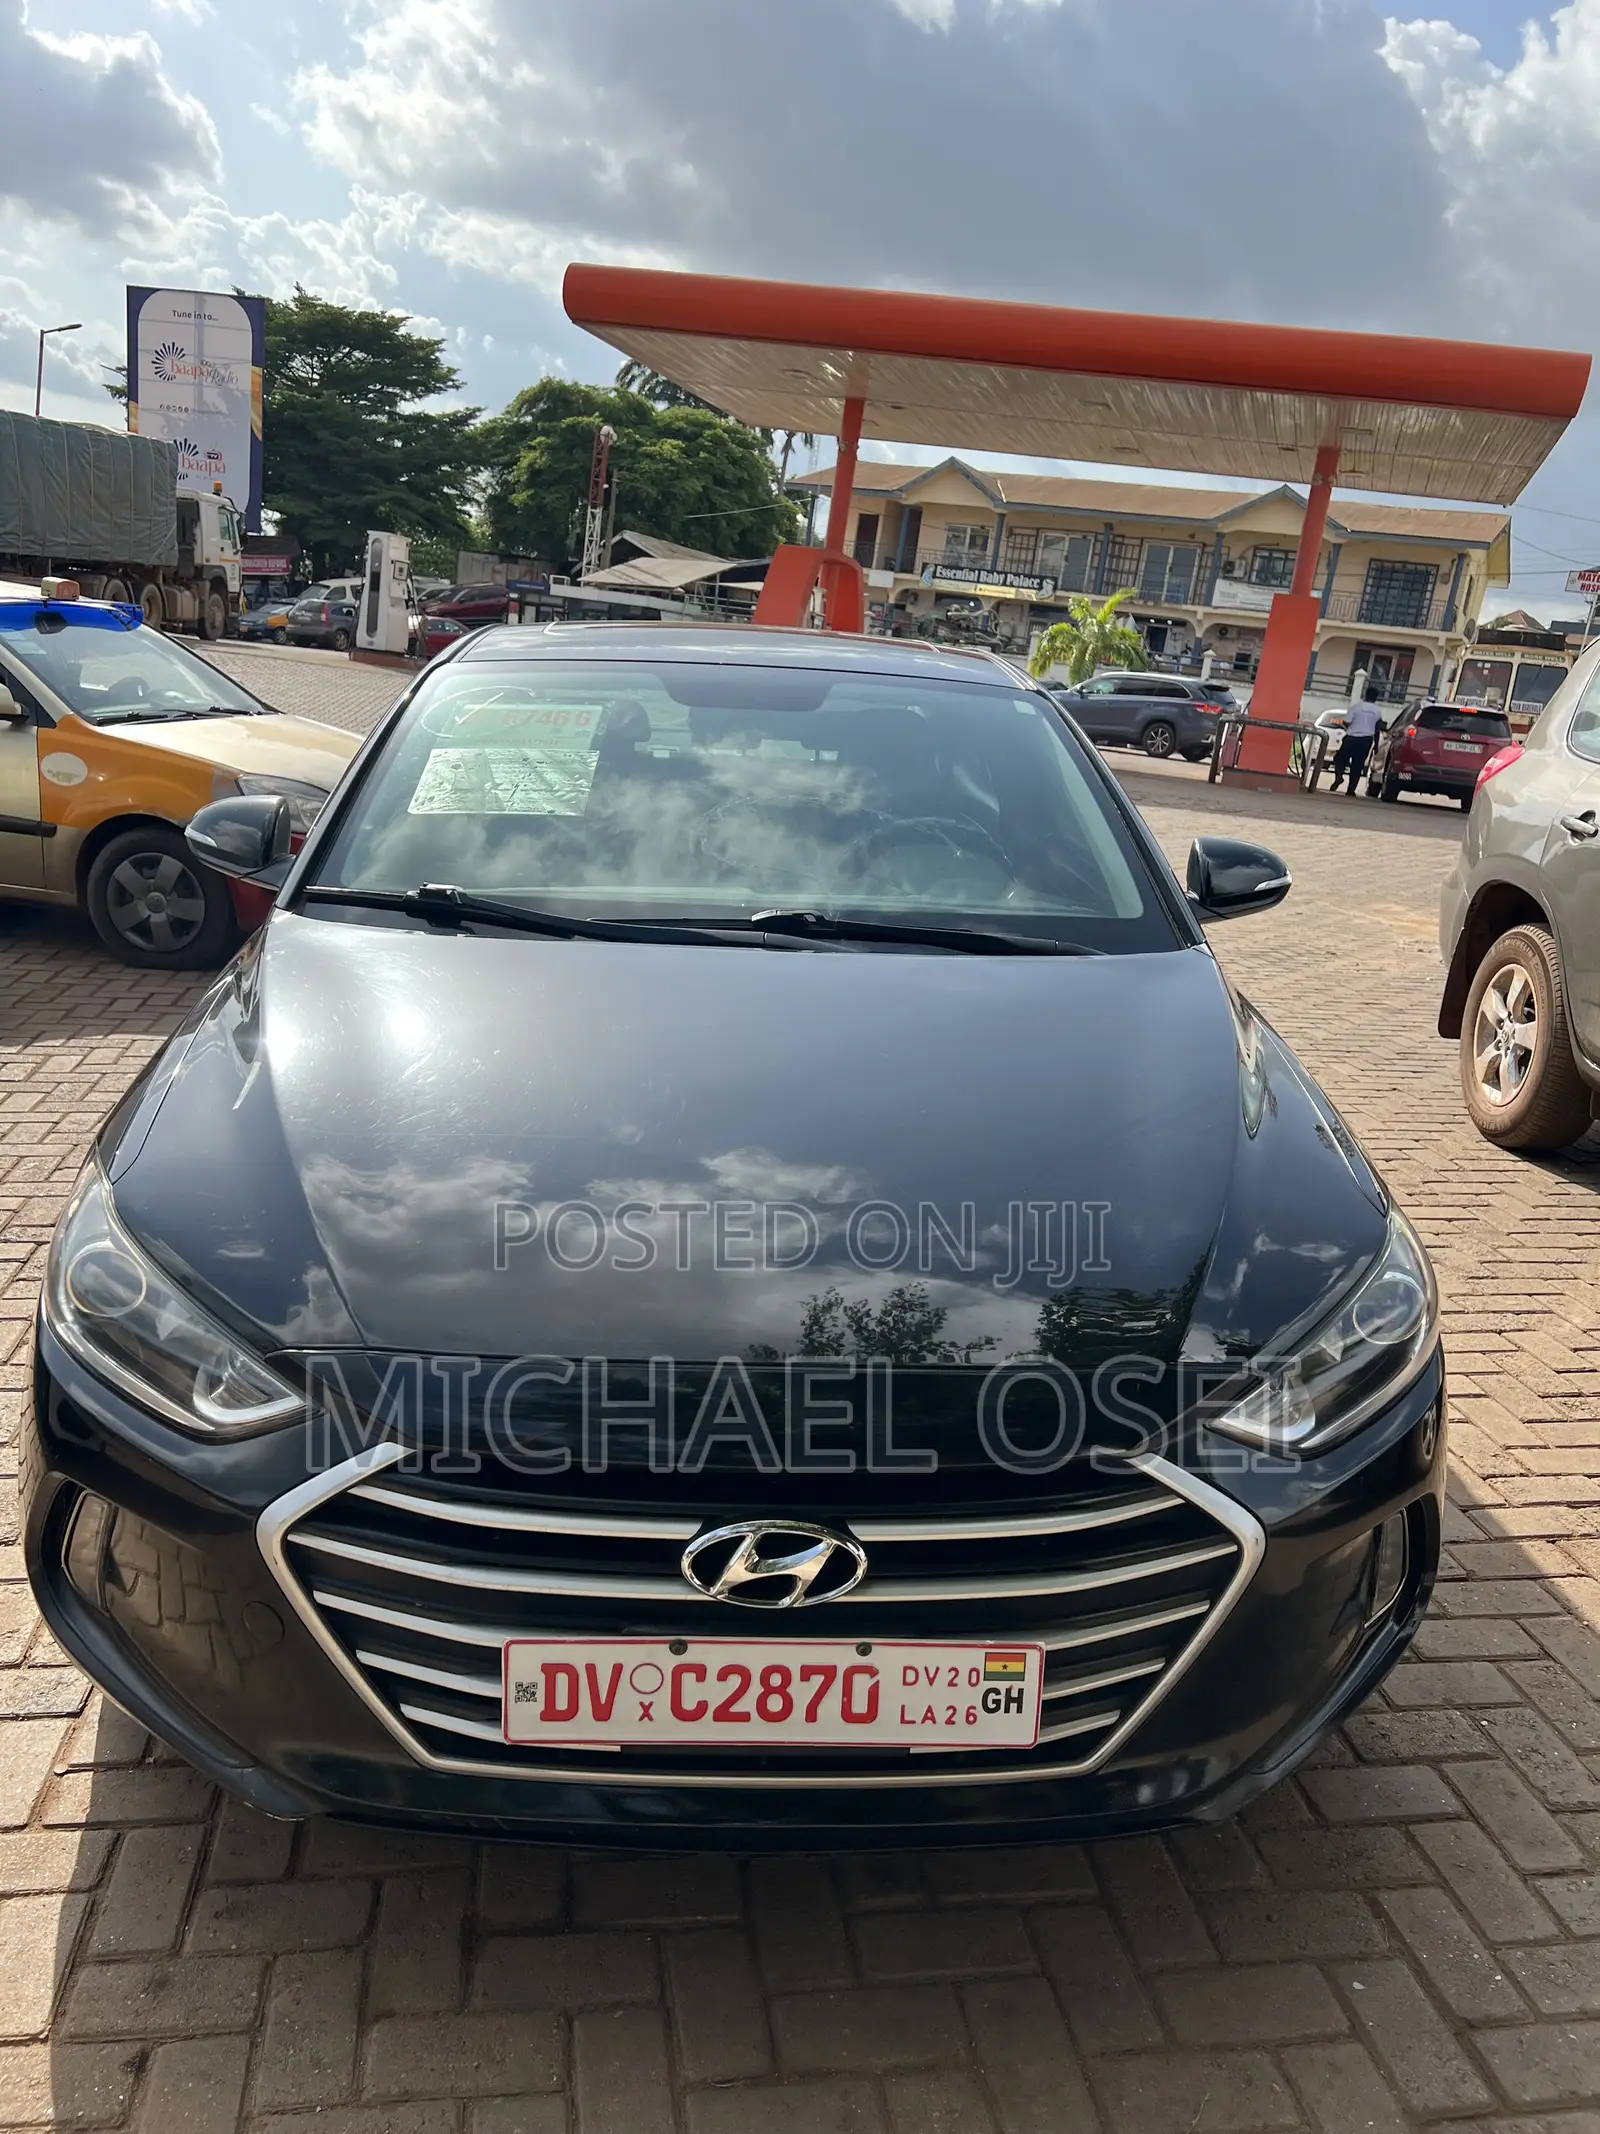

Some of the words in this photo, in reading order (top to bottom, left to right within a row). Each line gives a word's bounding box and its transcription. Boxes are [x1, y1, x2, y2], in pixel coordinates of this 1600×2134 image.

[172, 310, 192, 318] Tune
[194, 311, 202, 319] in
[170, 359, 211, 380] baapa
[205, 366, 239, 386] Radio
[181, 453, 226, 477] baapa
[936, 565, 979, 582] Essential
[979, 571, 1005, 586] Baby
[1006, 573, 1041, 588] Palace
[540, 1663, 623, 1722] DV
[670, 1663, 880, 1724] C2870
[981, 1686, 1025, 1715] GH
